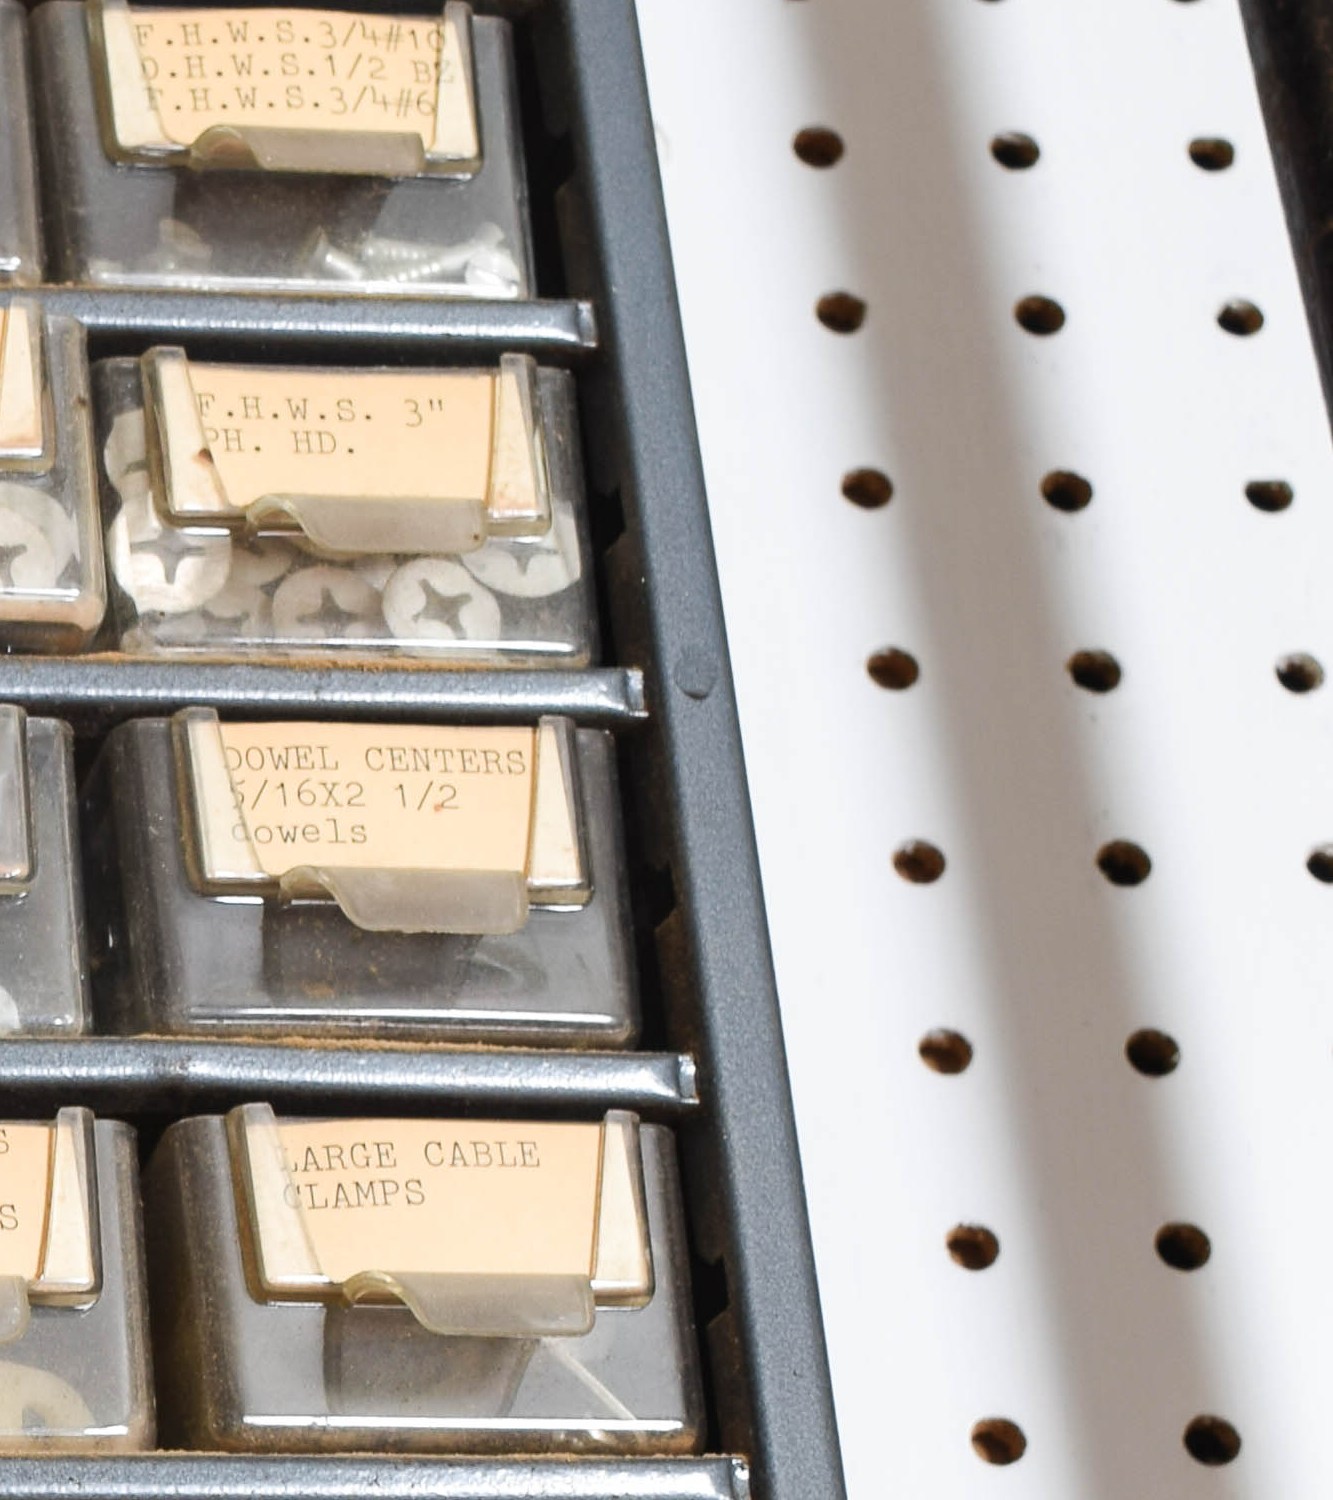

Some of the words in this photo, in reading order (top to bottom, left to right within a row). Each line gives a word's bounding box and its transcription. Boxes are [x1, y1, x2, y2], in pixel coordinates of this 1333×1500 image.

[196, 393, 372, 422] F.H.W.S.
[404, 399, 445, 428] 3"
[292, 430, 354, 455] HD.
[365, 746, 527, 777] CENTERS
[394, 780, 460, 812] 1/2
[424, 1140, 542, 1169] CABLE
